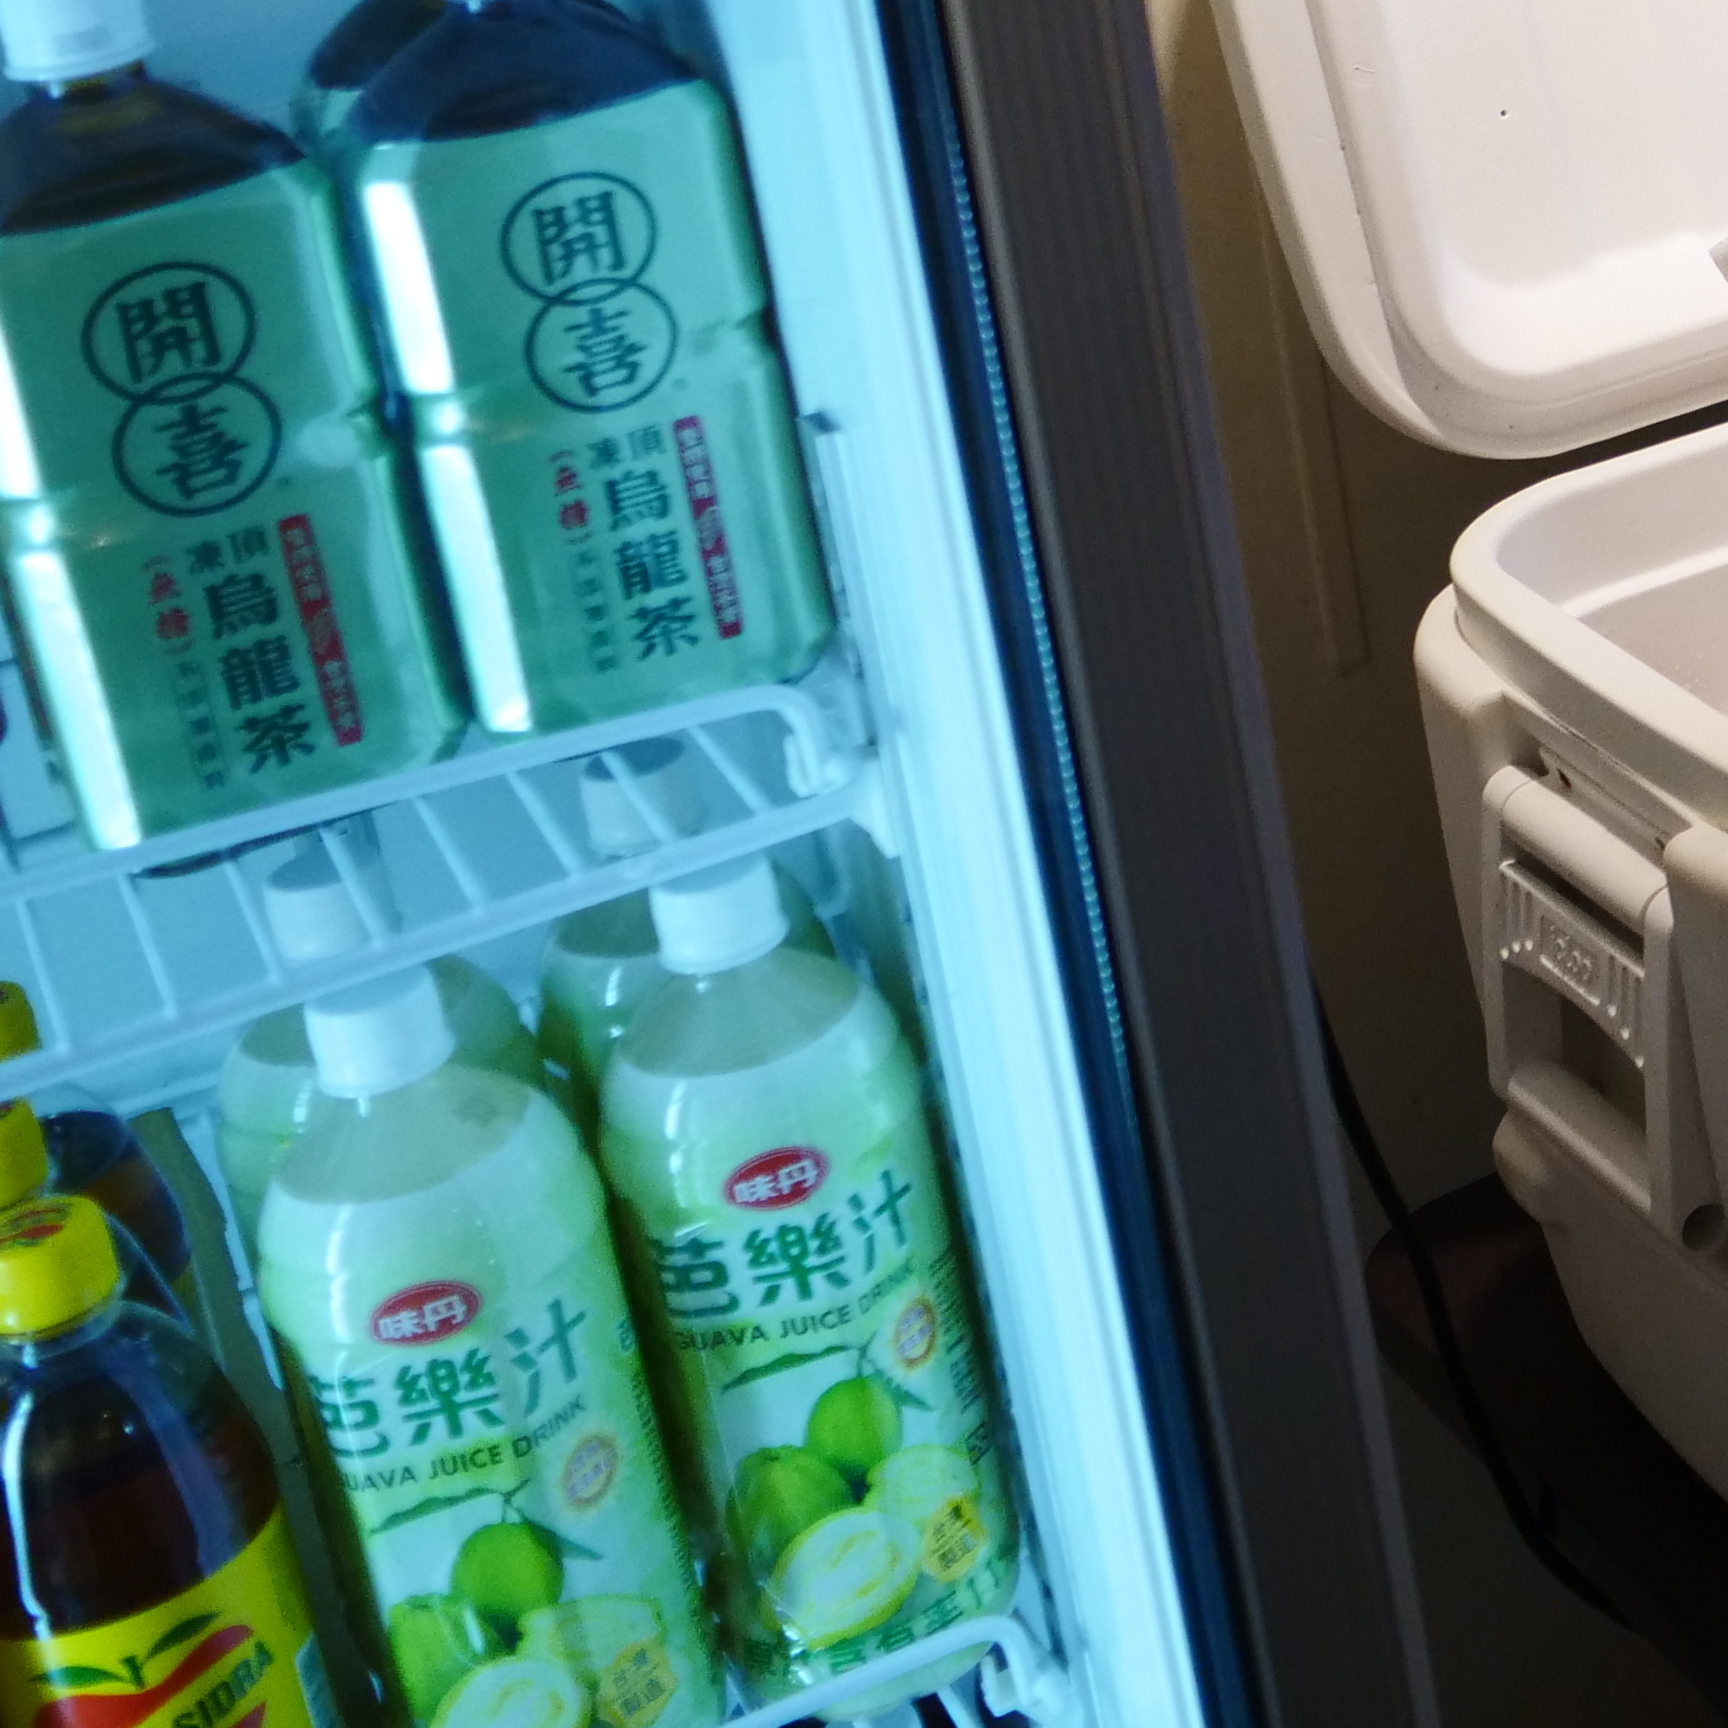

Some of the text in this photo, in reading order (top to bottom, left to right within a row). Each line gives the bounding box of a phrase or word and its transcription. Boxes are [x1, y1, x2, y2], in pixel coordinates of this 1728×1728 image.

[531, 190, 648, 398] 開喜
[114, 279, 250, 501] 開喜
[602, 468, 700, 662] 烏龍茶
[203, 571, 316, 775] 烏龍茶
[651, 1169, 912, 1320] 芭樂汁
[734, 1159, 821, 1205] 味丹
[313, 1298, 587, 1460] 芭樂汁
[377, 1294, 470, 1342] 味丹
[779, 1304, 852, 1342] JUICE
[341, 1393, 587, 1494] UAVA JUICE DRINK
